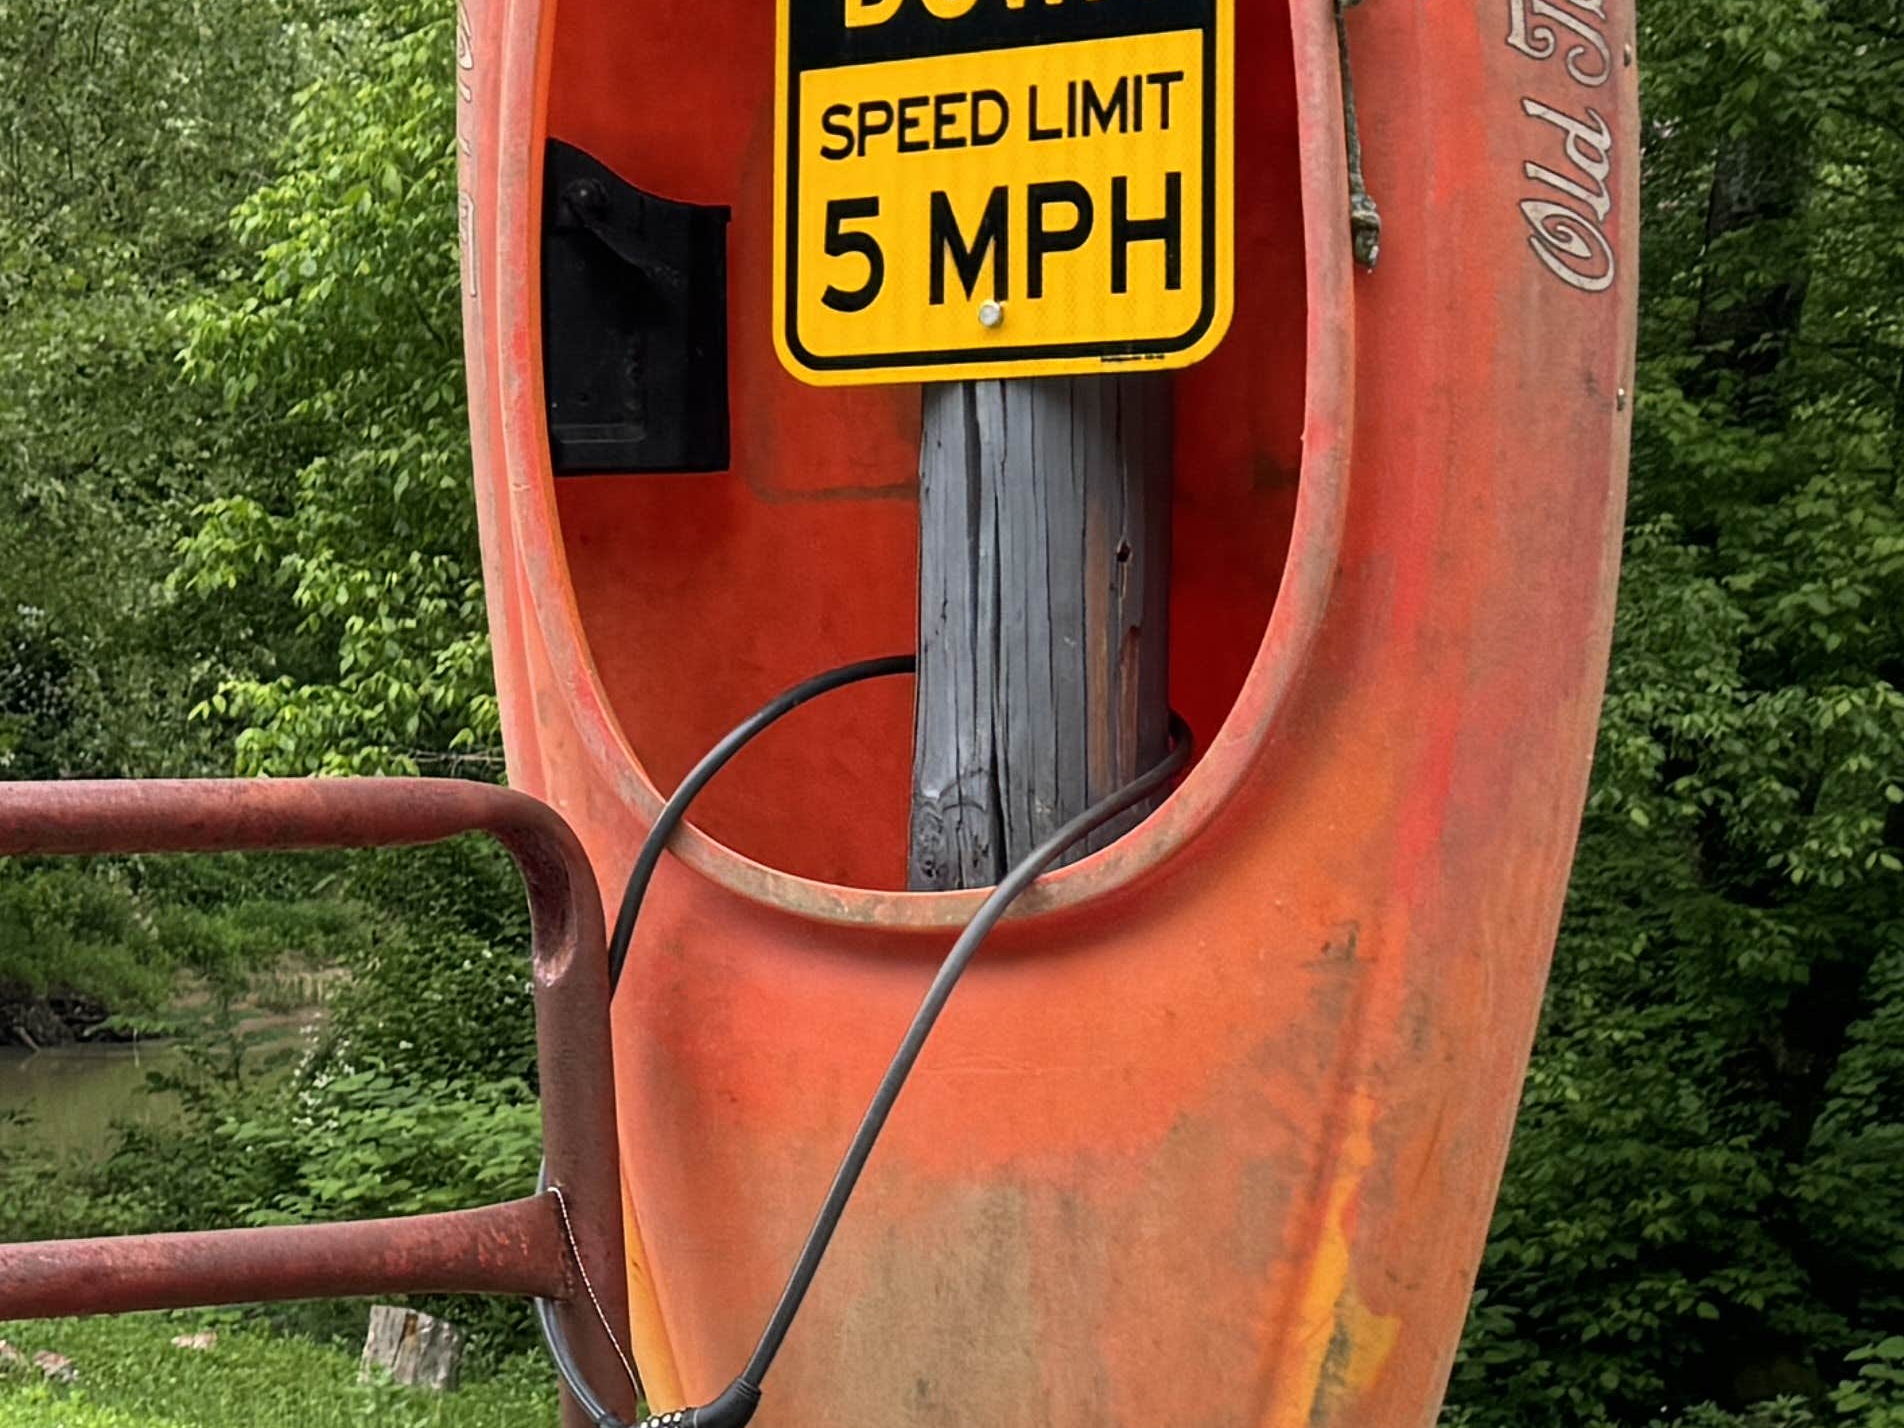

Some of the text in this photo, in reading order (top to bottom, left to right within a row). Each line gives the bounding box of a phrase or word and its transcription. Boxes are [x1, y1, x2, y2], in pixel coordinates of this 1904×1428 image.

[820, 71, 1184, 160] SPEED LIMIT
[821, 171, 1182, 313] 5 MPH
[1519, 97, 1615, 291] Old
